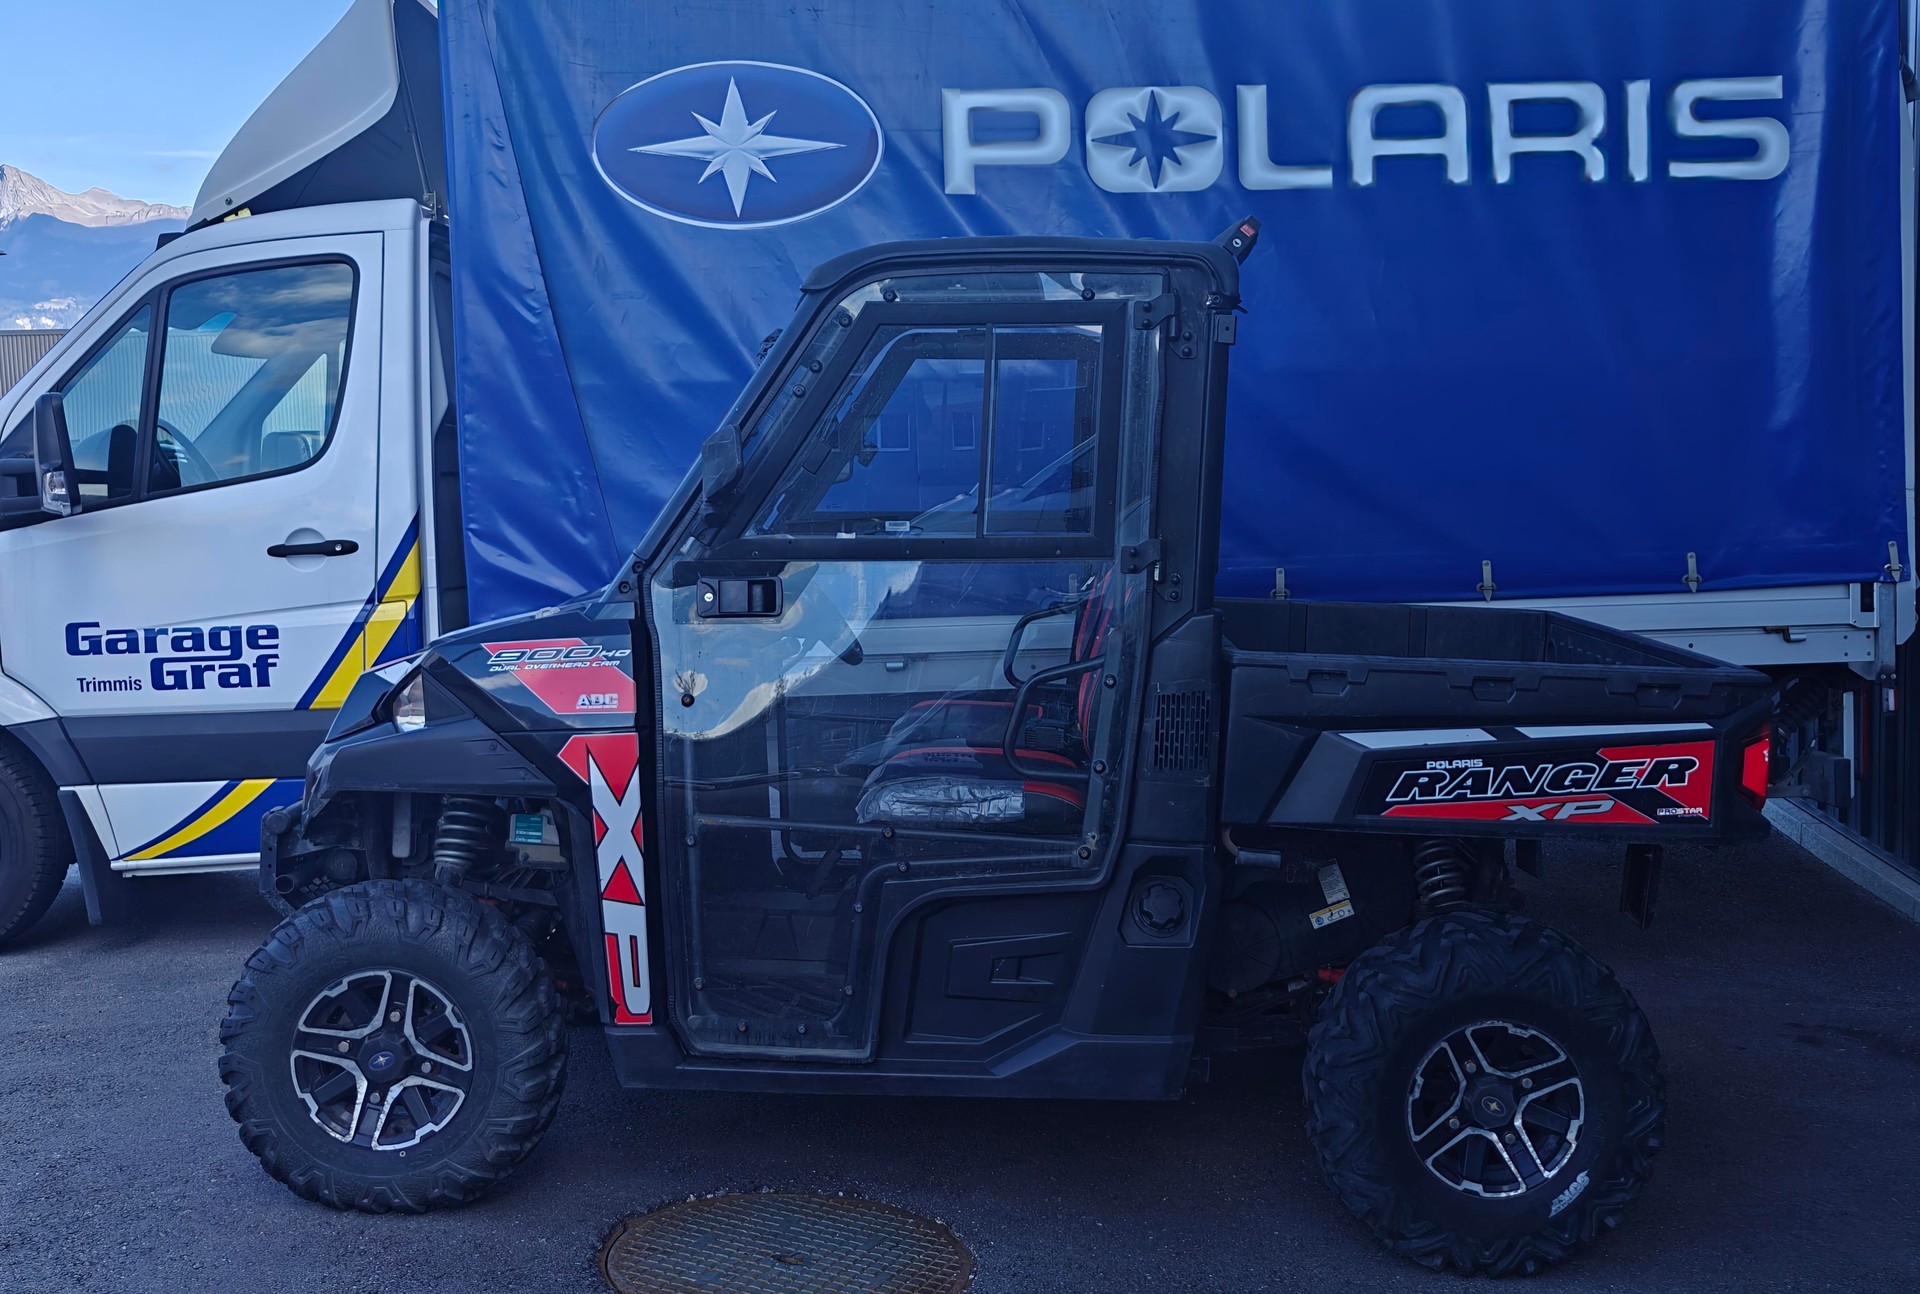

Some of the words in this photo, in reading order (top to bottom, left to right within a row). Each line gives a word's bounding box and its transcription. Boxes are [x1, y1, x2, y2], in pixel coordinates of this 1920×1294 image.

[941, 75, 1790, 195] POLARIS
[65, 621, 280, 661] Garage
[150, 653, 280, 691] Graf
[490, 664, 521, 672] DUAL
[525, 661, 590, 670] OVERHEAD
[77, 676, 142, 692] Trimmis
[1426, 759, 1483, 769] POLARIS
[1386, 756, 1699, 801] RANGER
[1501, 800, 1615, 821] XP
[1656, 807, 1703, 816] PROSTAR
